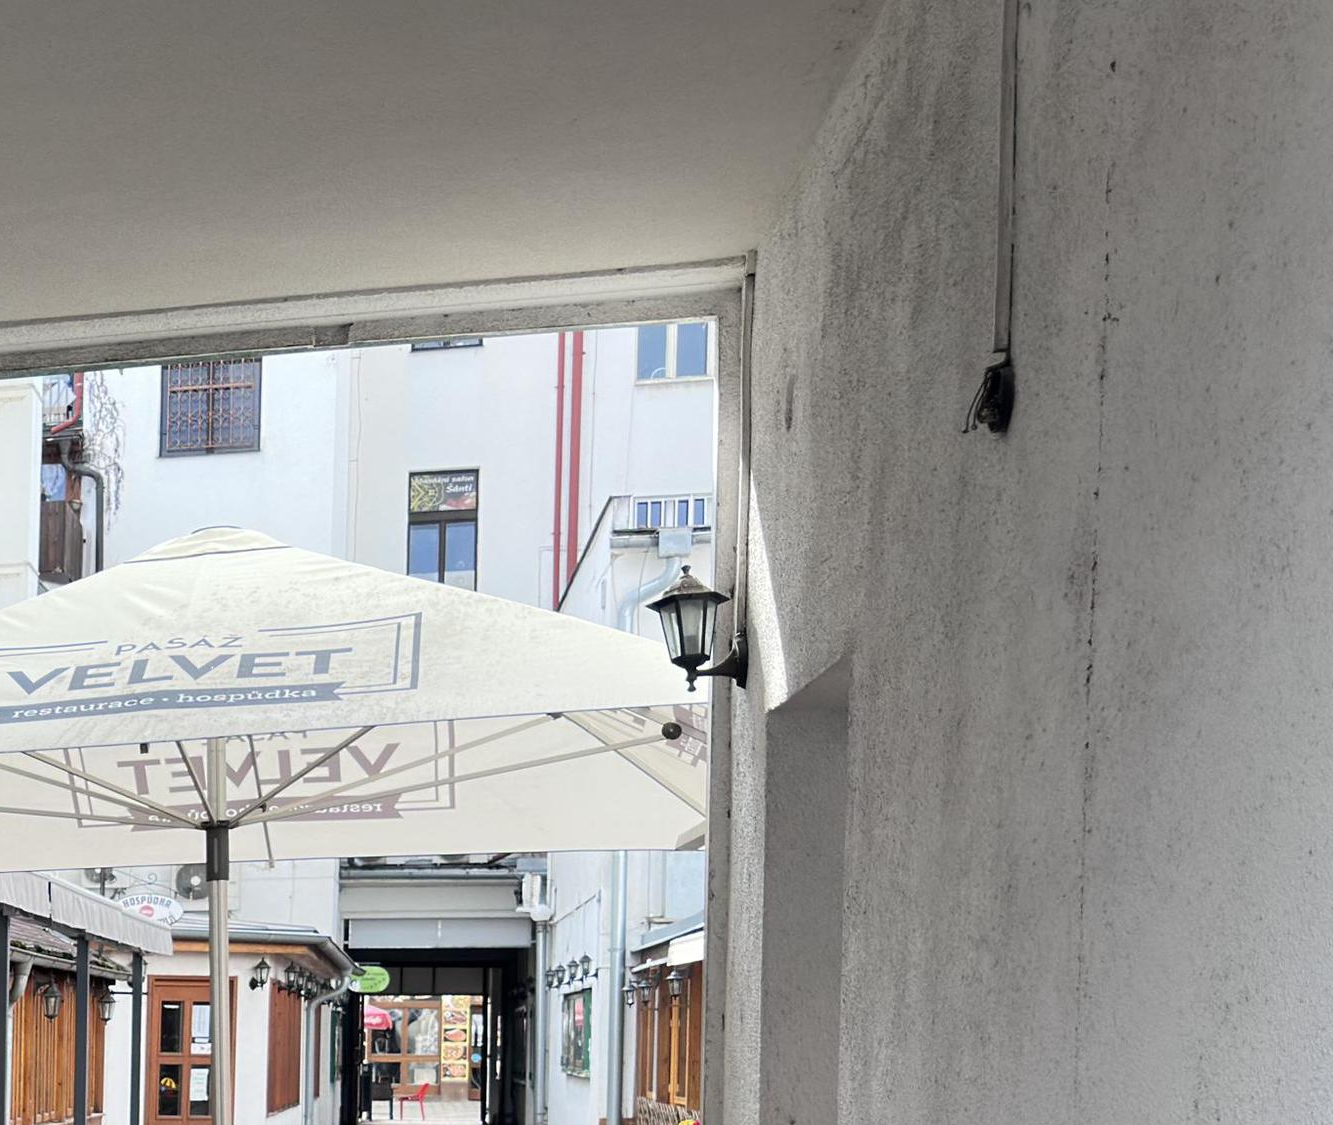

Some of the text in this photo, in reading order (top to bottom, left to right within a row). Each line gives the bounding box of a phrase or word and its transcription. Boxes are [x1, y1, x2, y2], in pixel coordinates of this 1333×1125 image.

[114, 635, 245, 656] PASÁŽ
[7, 647, 352, 696] VELVET
[11, 686, 318, 720] restaurace hospůdka
